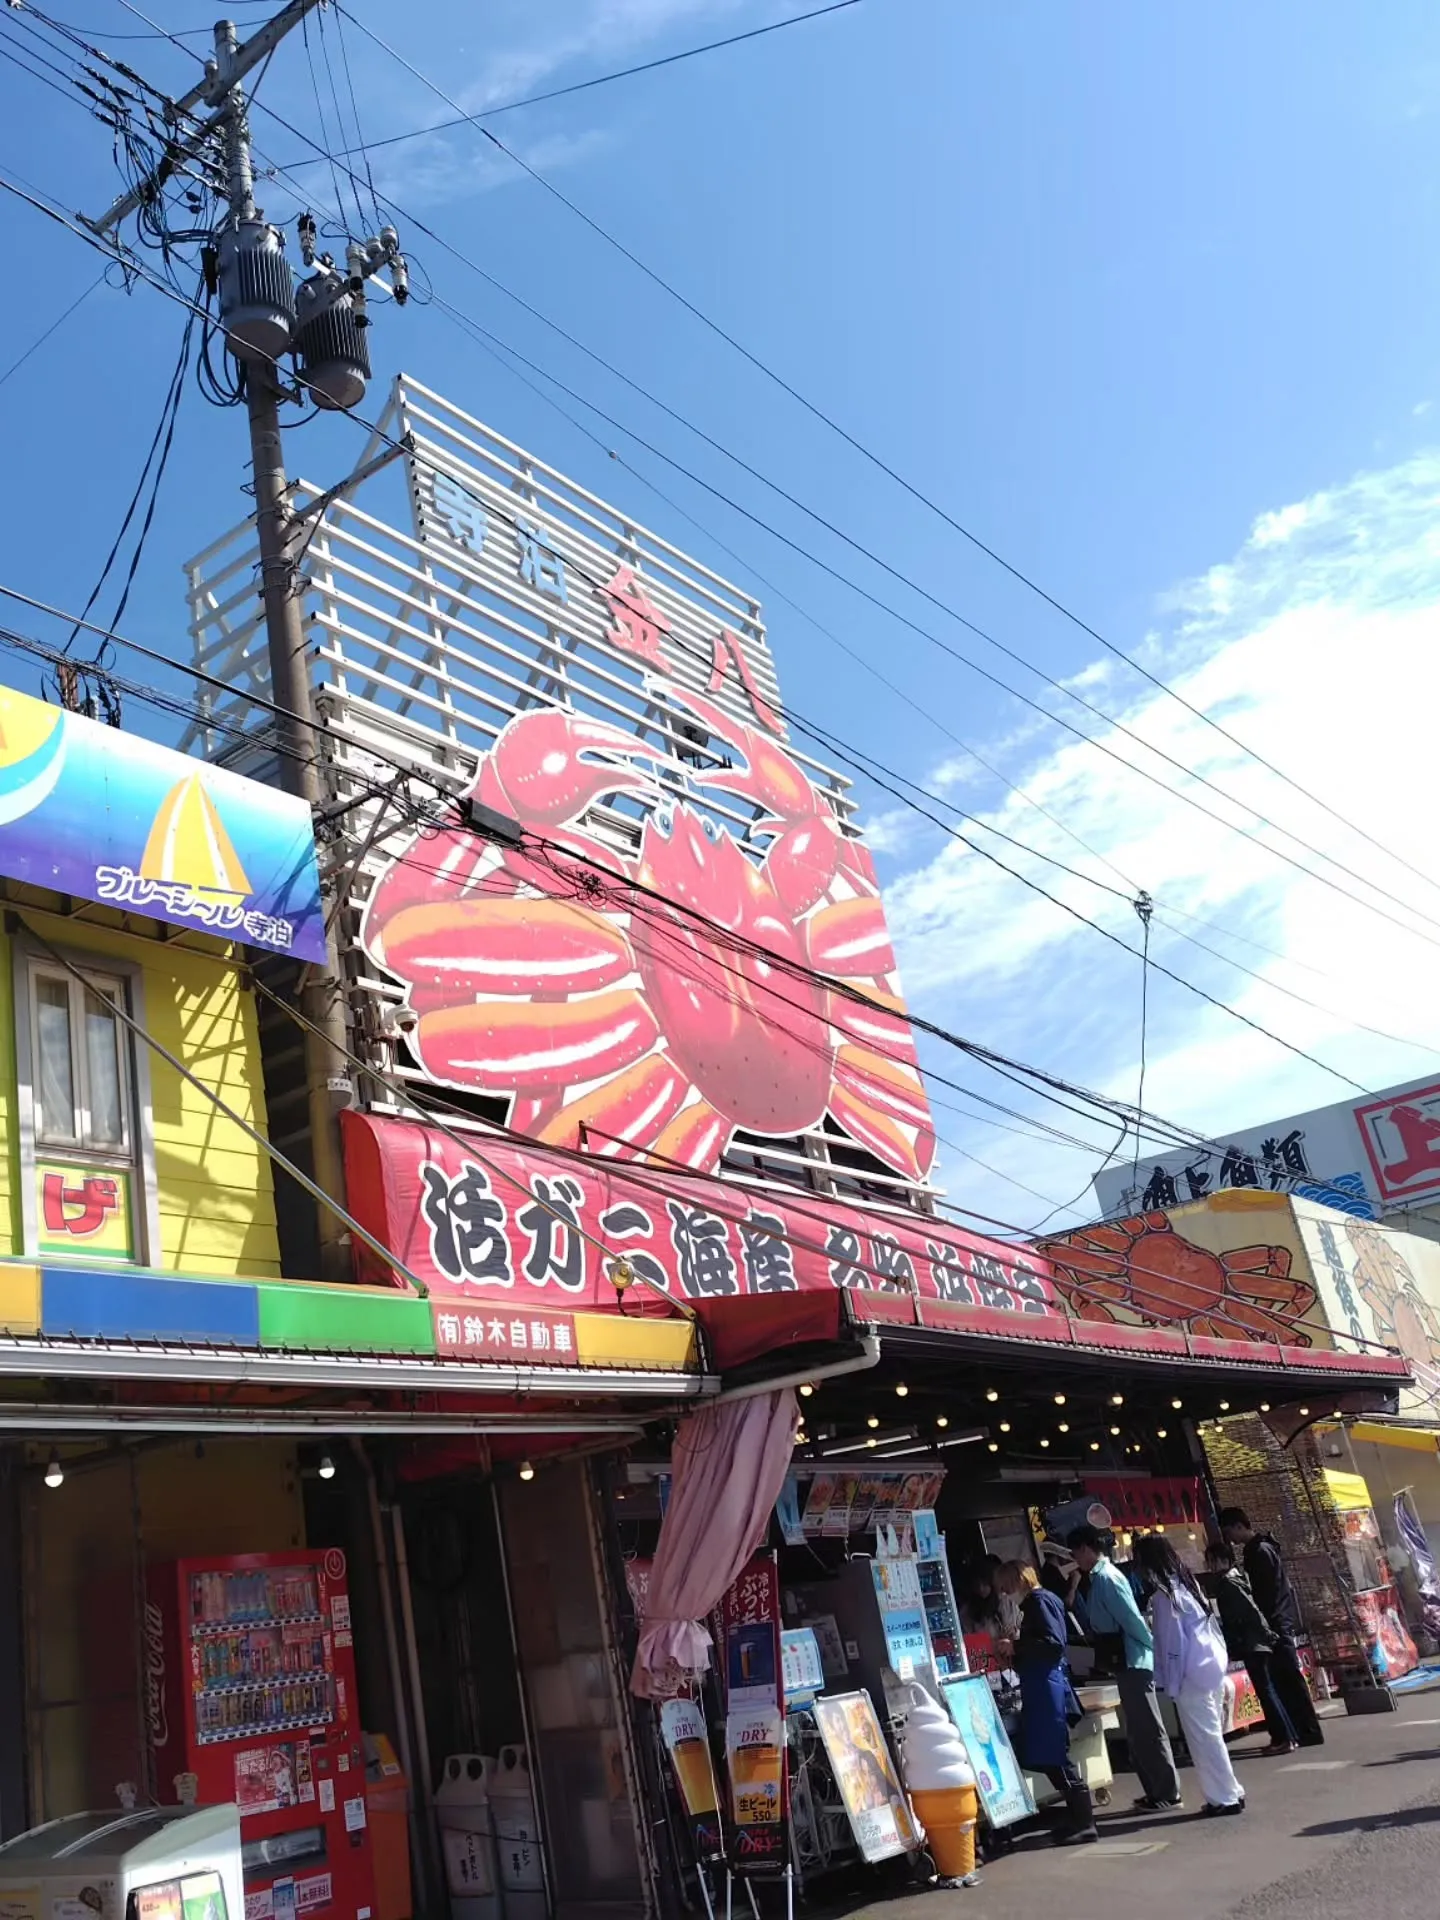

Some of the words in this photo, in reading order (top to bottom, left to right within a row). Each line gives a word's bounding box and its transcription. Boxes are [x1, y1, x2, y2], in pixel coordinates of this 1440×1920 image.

[42, 1172, 118, 1236] げ
[739, 1797, 777, 1812] 生ビール
